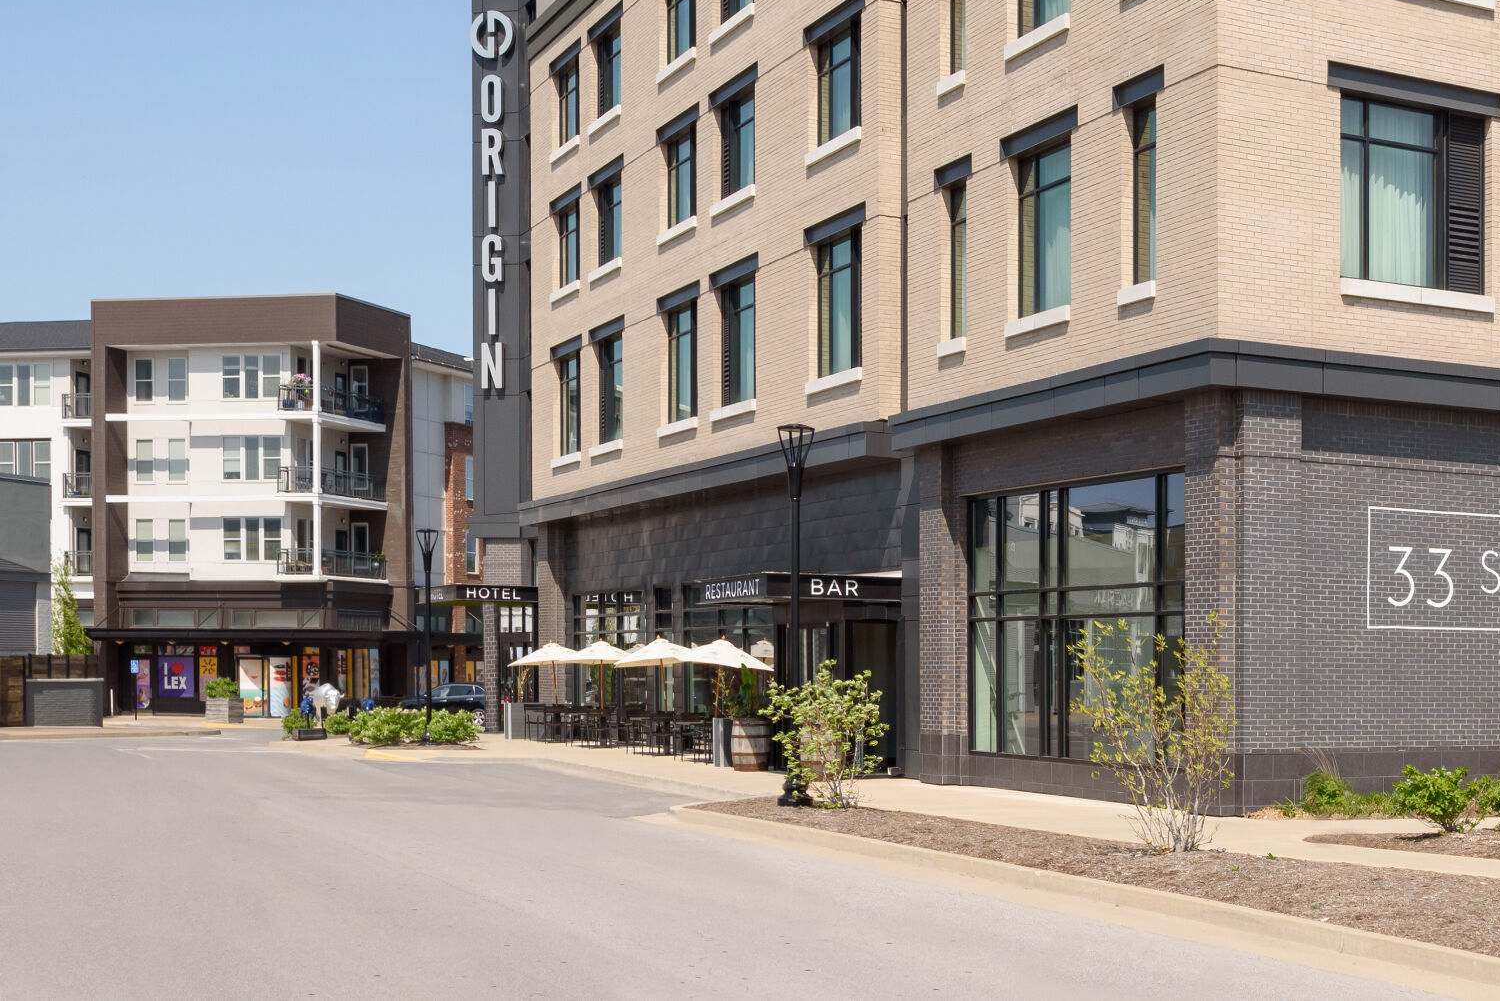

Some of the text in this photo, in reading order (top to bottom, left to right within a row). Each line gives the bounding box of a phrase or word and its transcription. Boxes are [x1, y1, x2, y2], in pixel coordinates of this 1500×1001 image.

[481, 74, 504, 389] ORIGIN
[1387, 546, 1454, 608] 33
[466, 587, 521, 600] HOTEL
[705, 578, 760, 600] RESTAURANT
[810, 578, 859, 597] BAR
[163, 662, 168, 675] I
[164, 676, 187, 690] LEX
